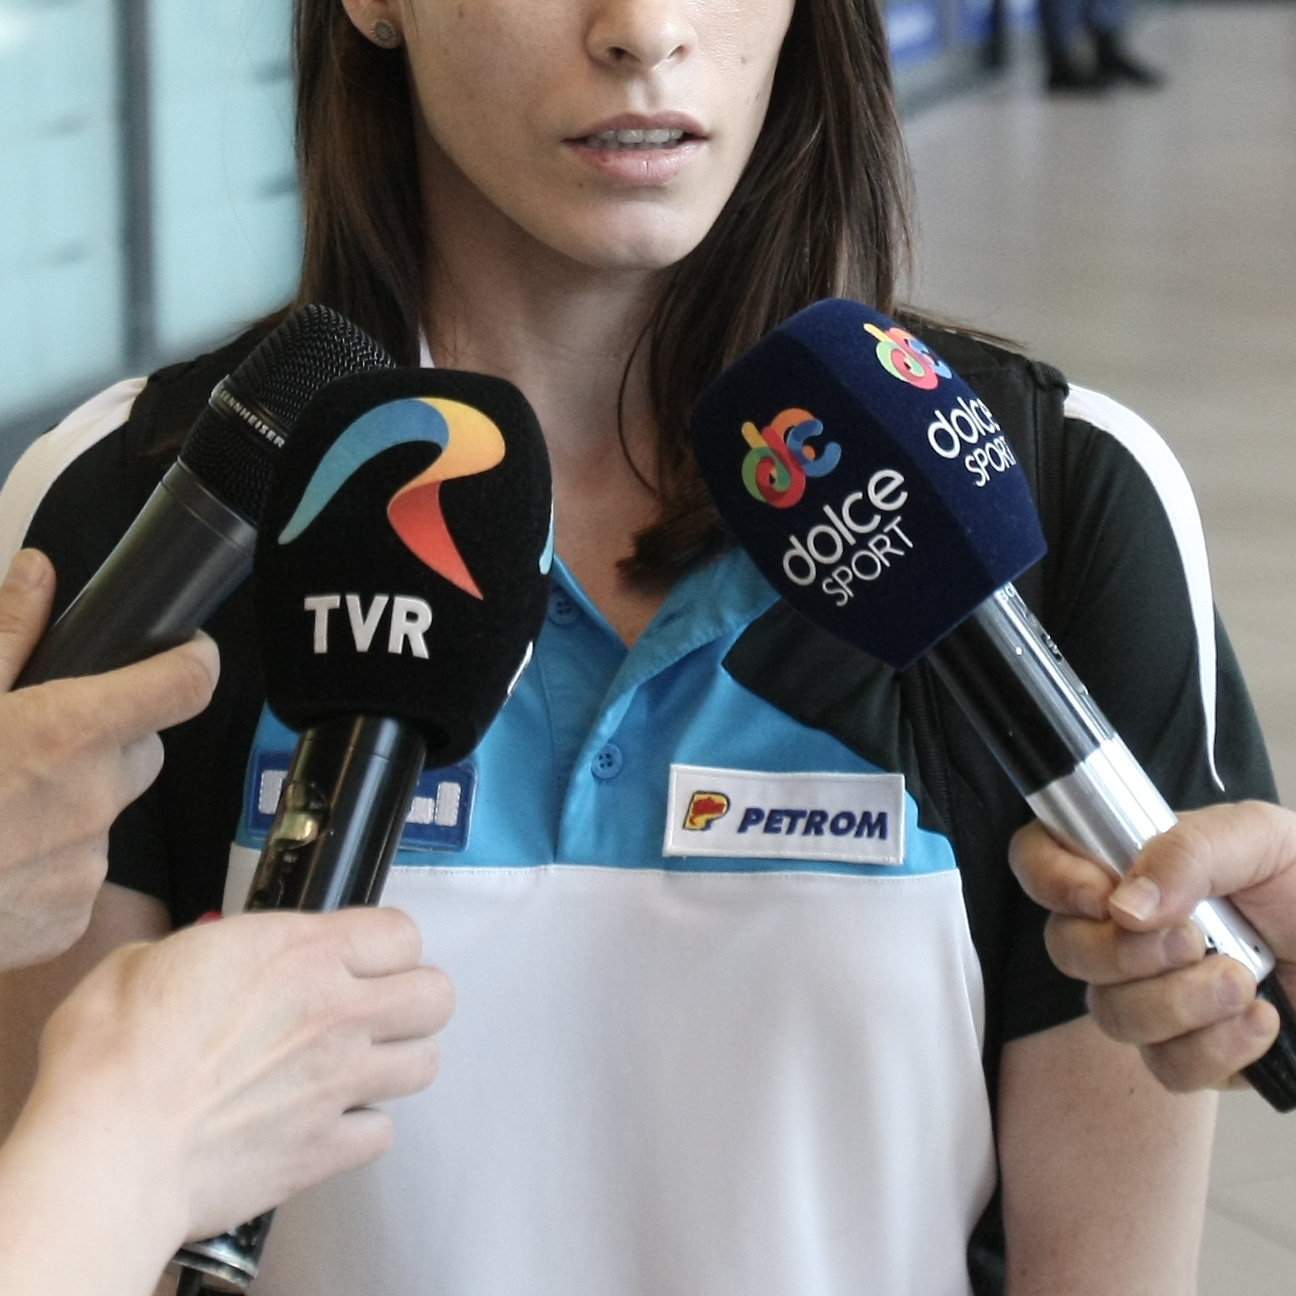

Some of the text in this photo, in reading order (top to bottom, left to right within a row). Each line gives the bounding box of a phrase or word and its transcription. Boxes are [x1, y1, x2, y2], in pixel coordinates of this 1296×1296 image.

[783, 469, 908, 586] dolce
[822, 516, 914, 607] SPORT
[304, 593, 433, 660] TVR
[737, 807, 889, 840] PETROM
